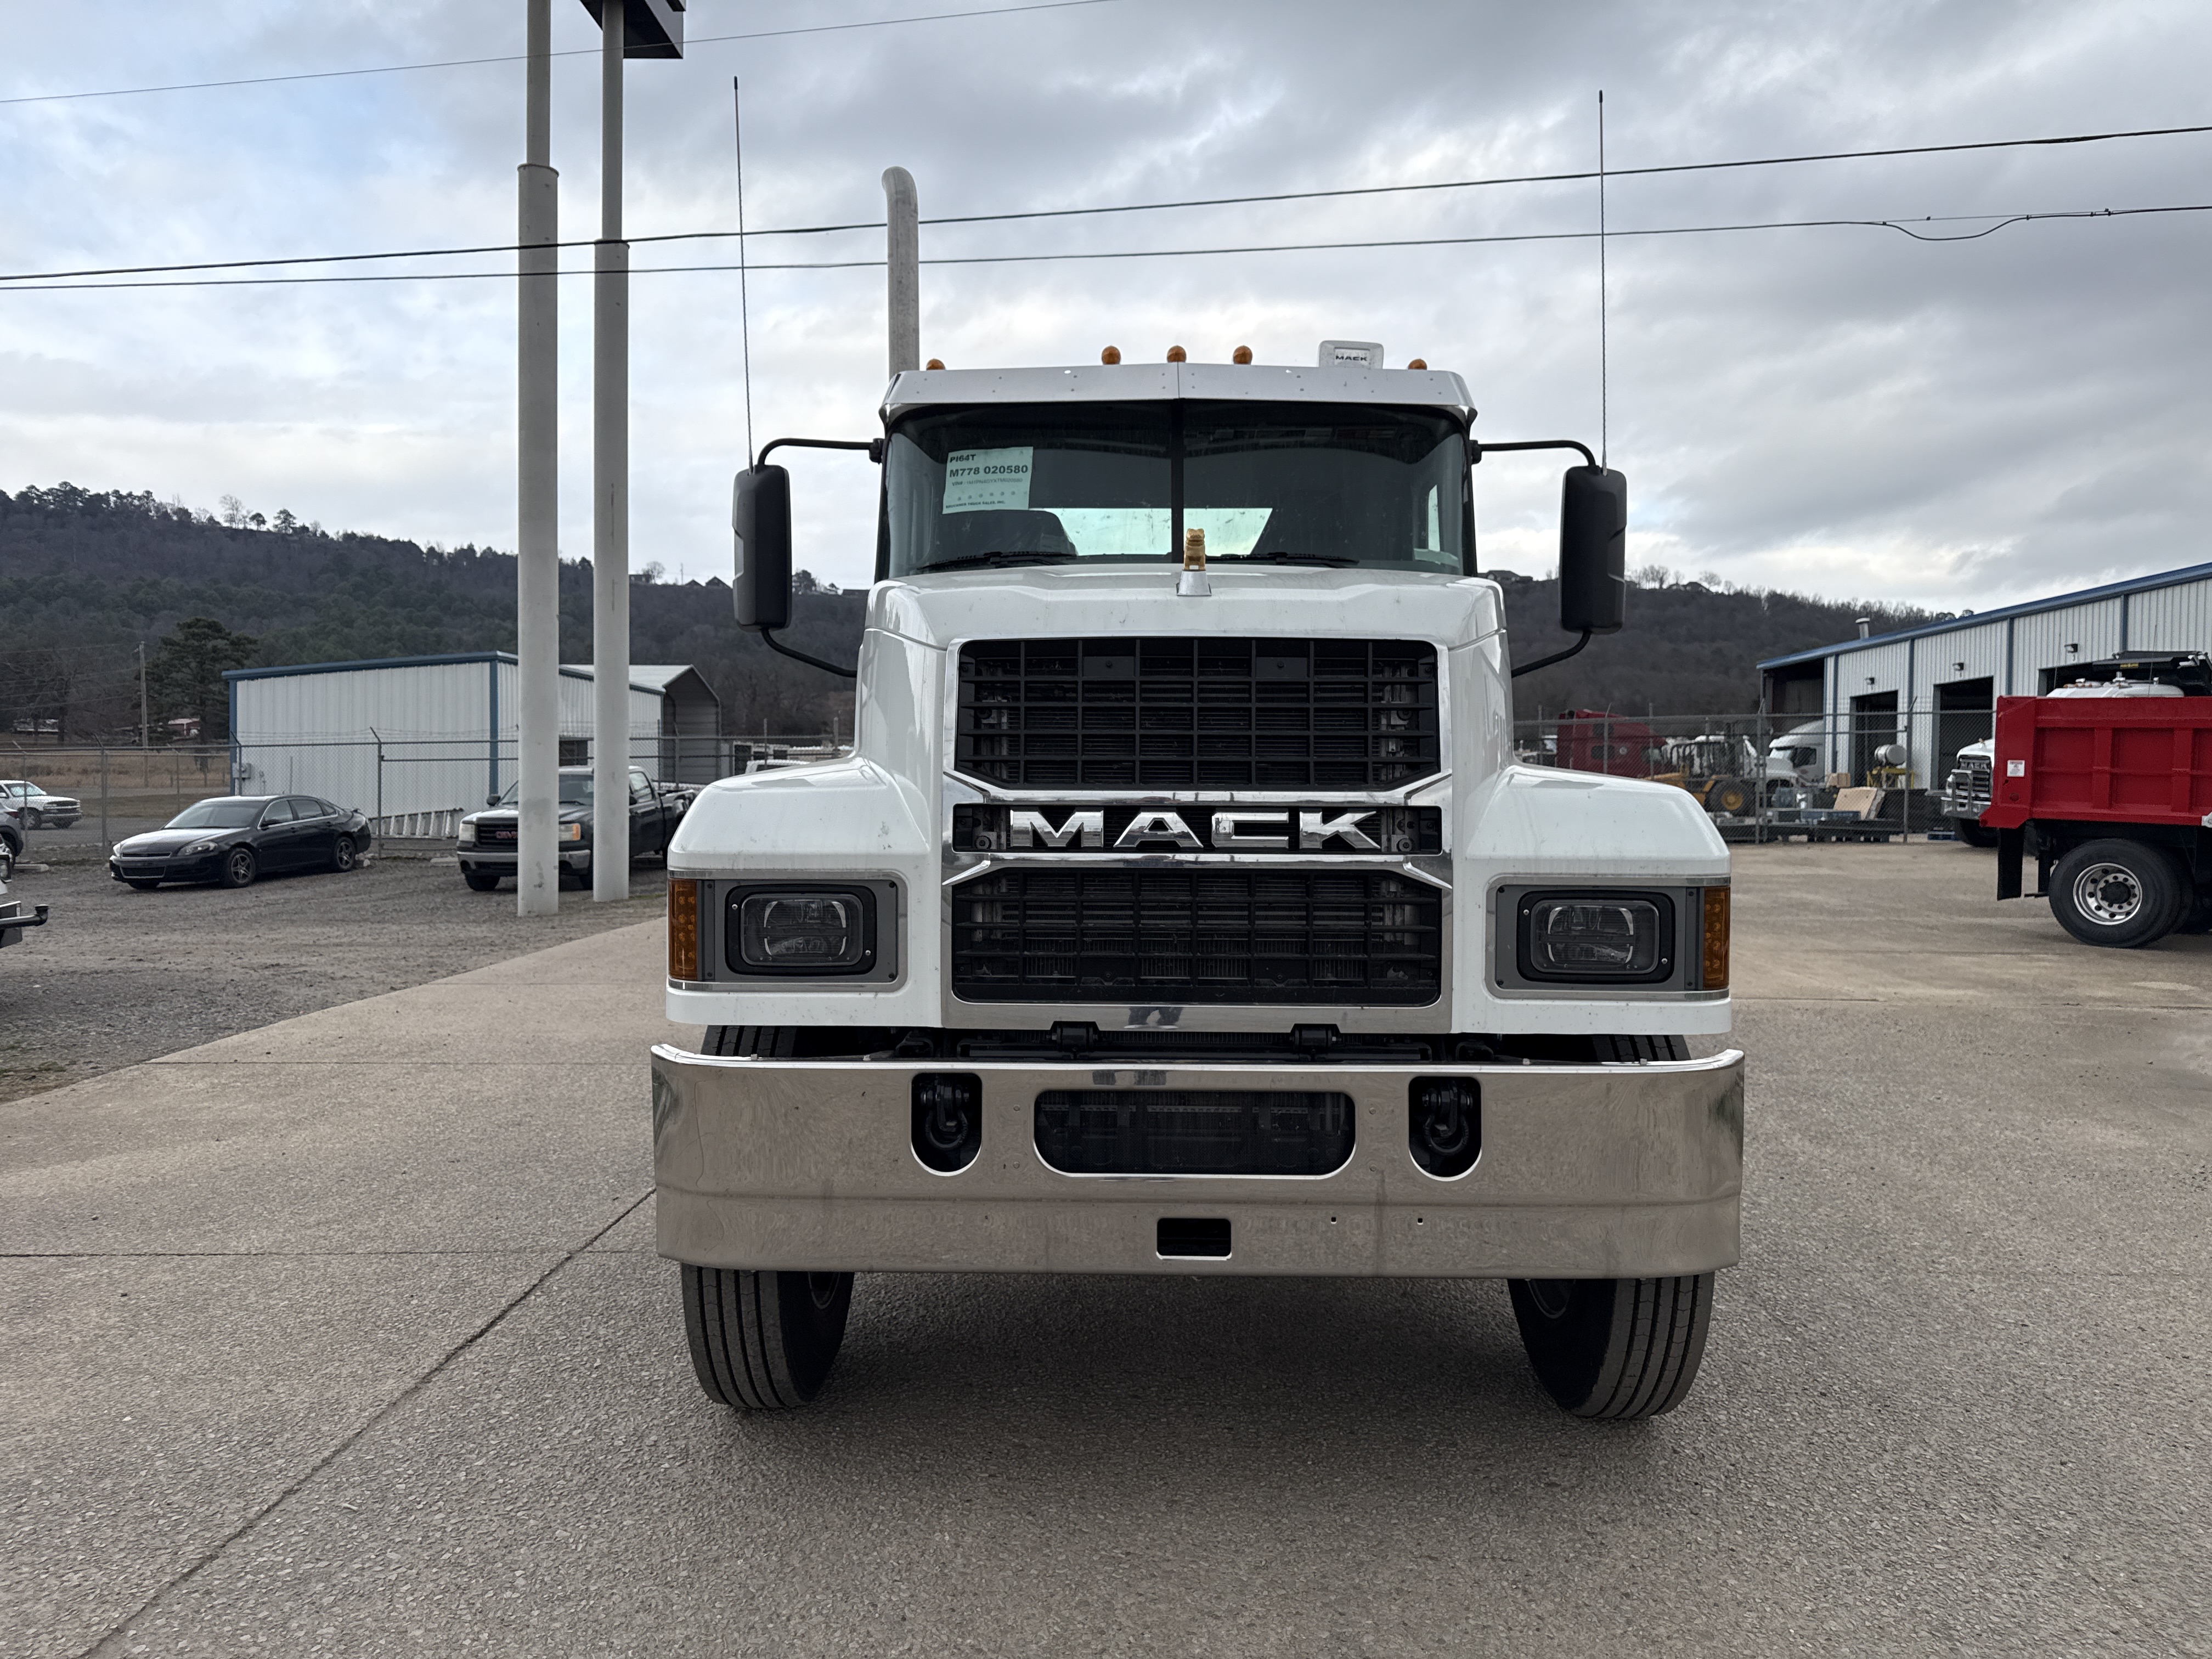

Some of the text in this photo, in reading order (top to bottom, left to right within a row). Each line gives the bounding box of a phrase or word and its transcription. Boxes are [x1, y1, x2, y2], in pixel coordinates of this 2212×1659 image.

[949, 465, 1028, 477] M778 020580
[1009, 809, 1381, 849] MACK
